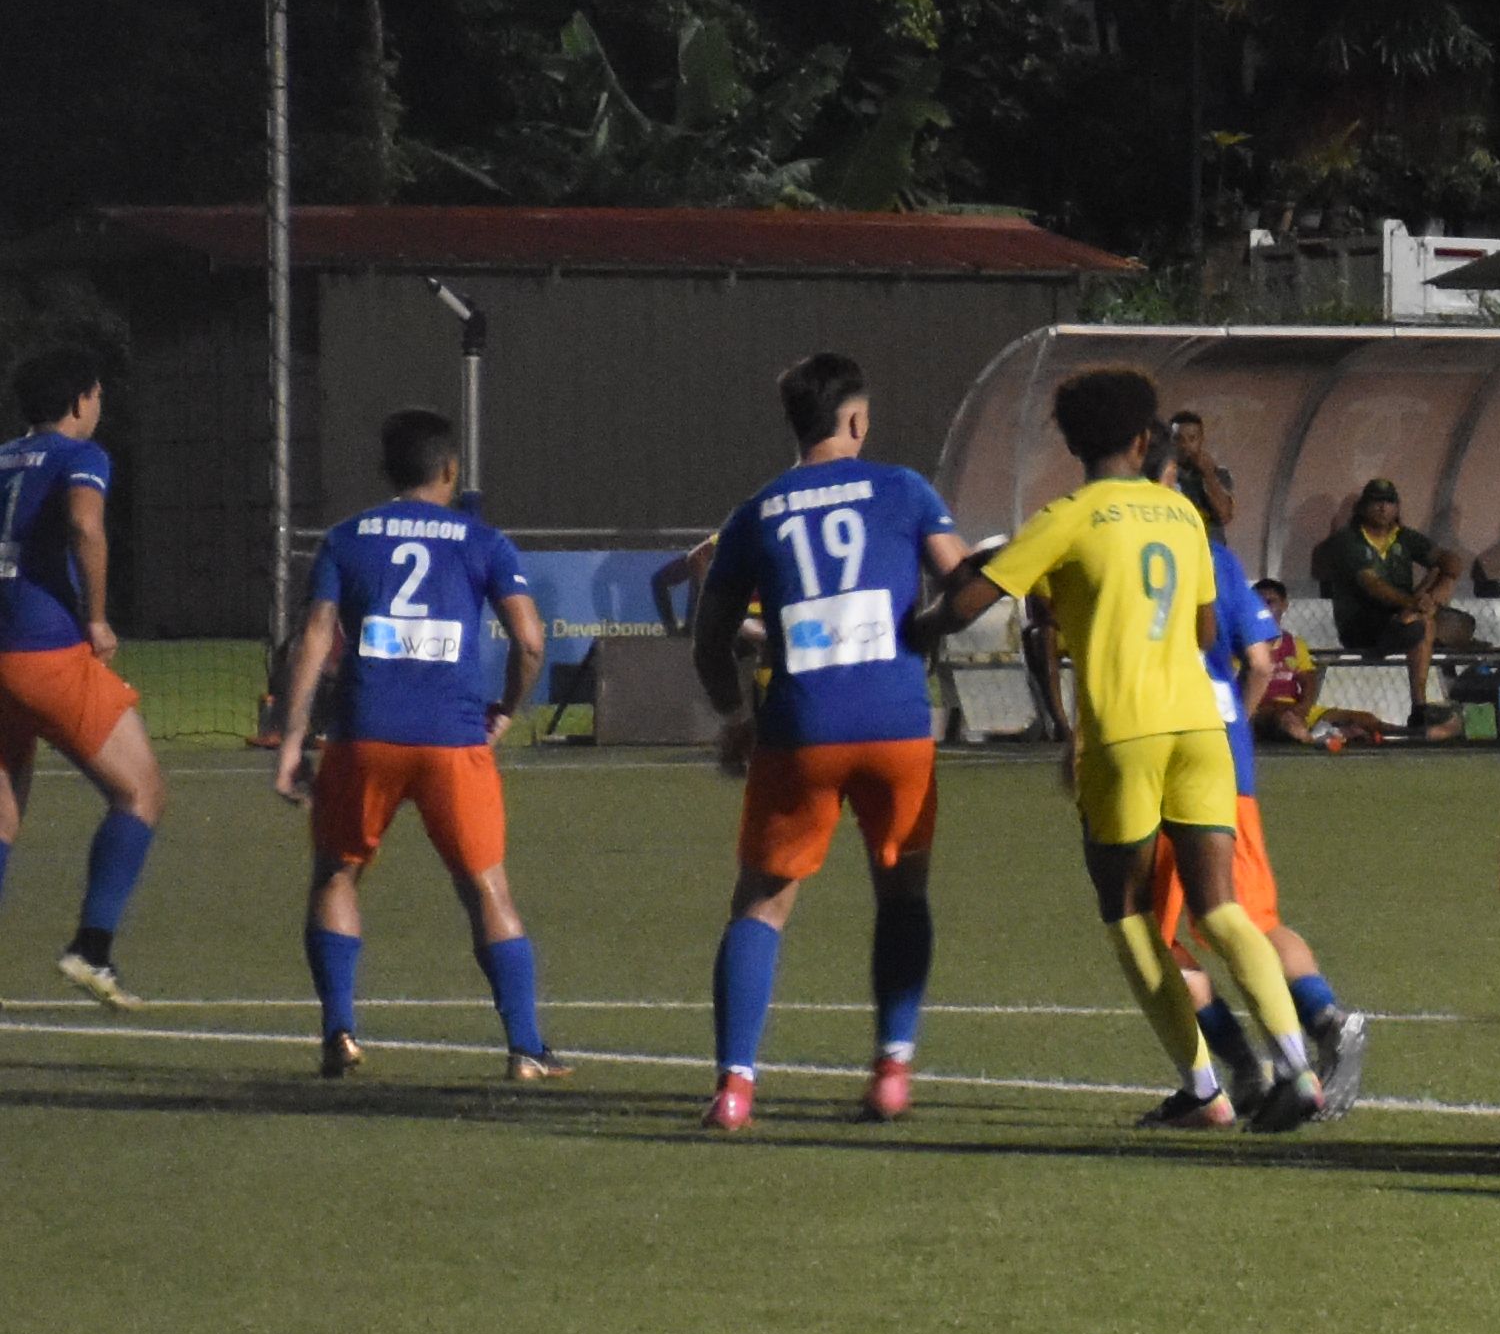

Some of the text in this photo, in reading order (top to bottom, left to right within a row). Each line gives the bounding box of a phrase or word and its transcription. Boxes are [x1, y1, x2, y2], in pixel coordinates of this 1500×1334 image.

[357, 517, 468, 542] AS DRAGON
[1126, 502, 1199, 529] TEFAN
[776, 507, 867, 598] 19
[389, 542, 431, 617] 2
[1140, 541, 1178, 641] 9
[401, 635, 457, 657] WCP
